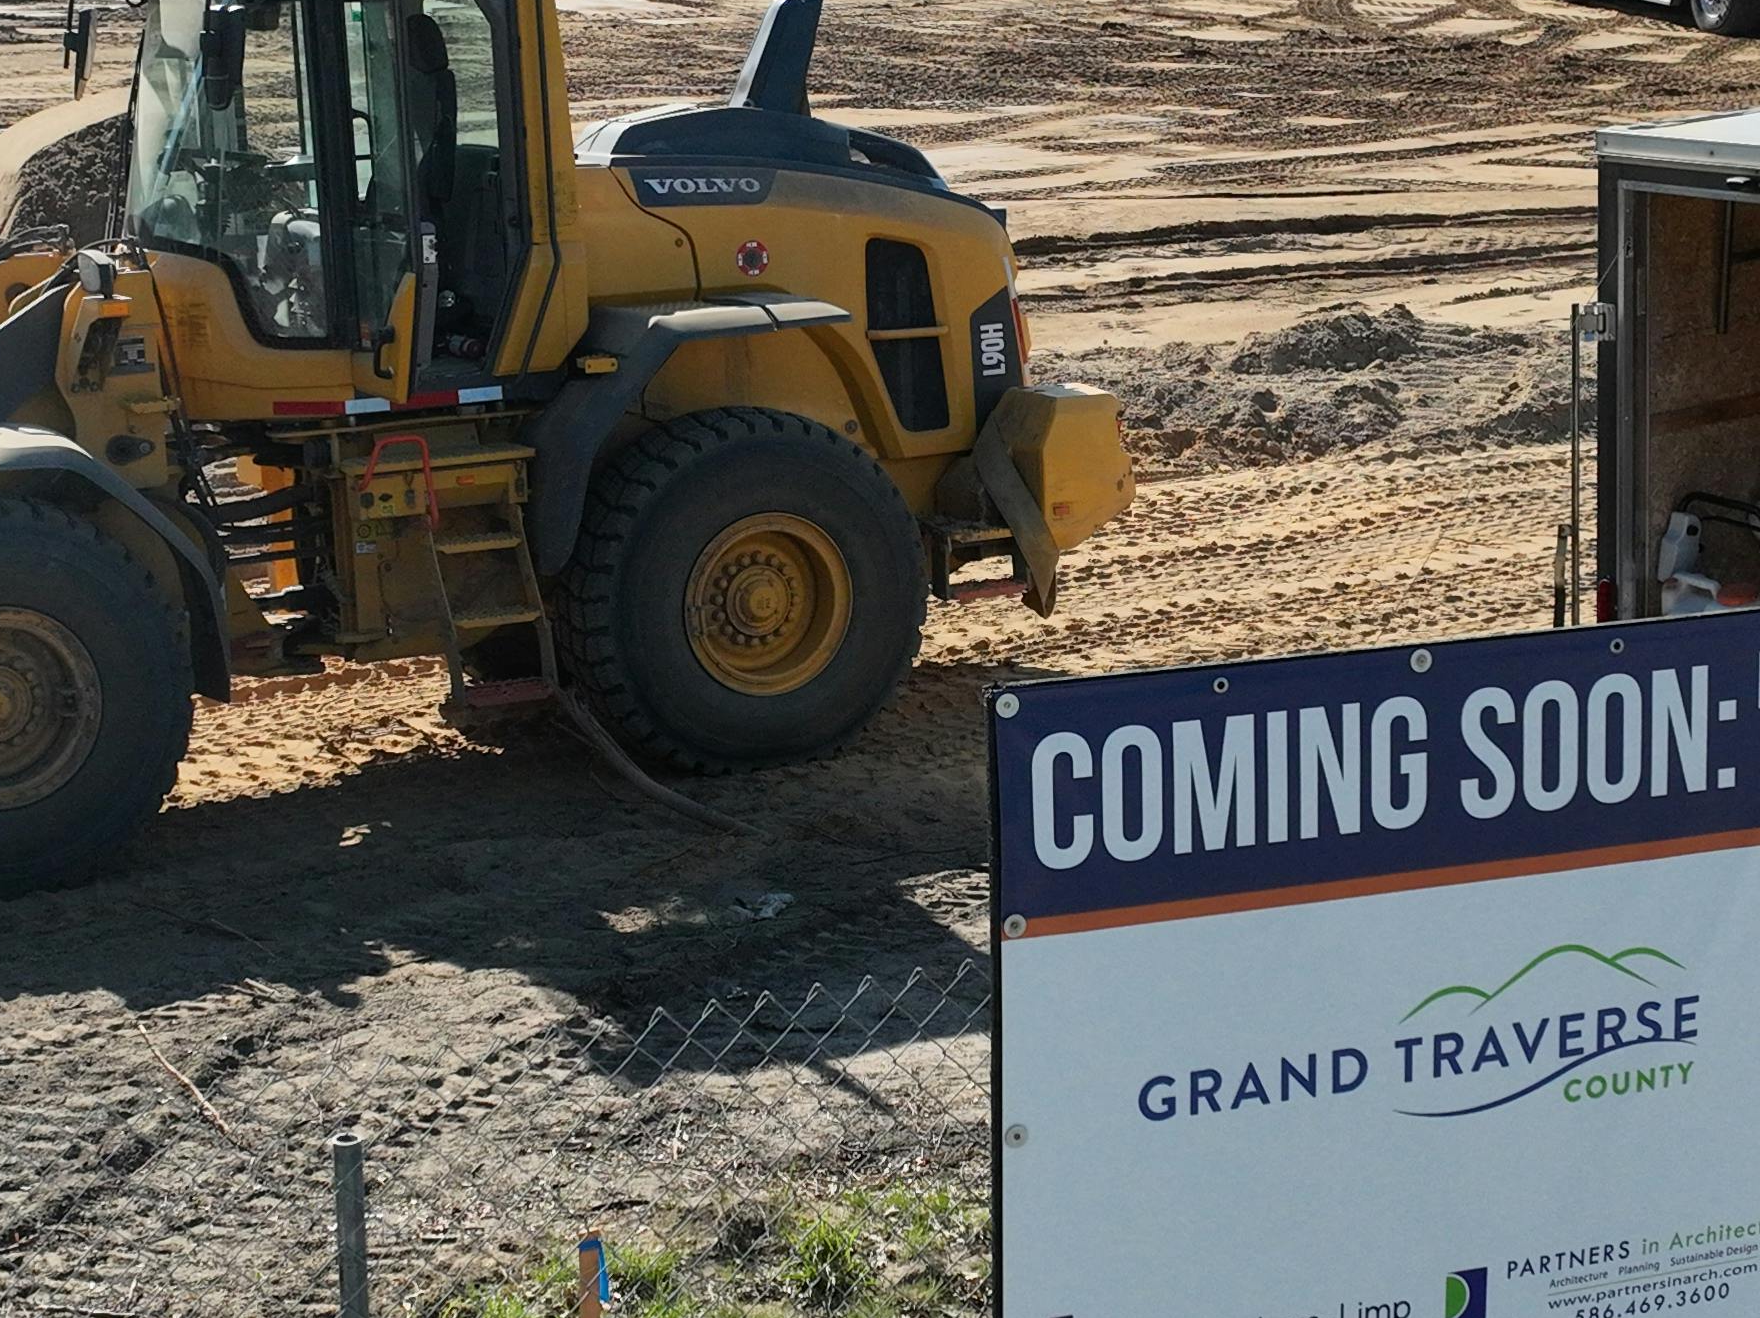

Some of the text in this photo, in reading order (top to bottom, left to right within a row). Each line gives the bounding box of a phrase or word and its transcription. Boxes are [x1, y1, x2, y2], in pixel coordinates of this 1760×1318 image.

[644, 177, 761, 194] VOLVO
[980, 323, 1006, 377] L90H
[1031, 665, 1737, 871] COMING SOON:
[1138, 995, 1700, 1121] GRAND TRAVERSE
[1563, 1061, 1694, 1103] COUNTY
[1507, 1241, 1631, 1280] PARTNERS
[1641, 1238, 1659, 1256] in
[1549, 1242, 1758, 1290] Architecture Planning Sustainable Design
[1547, 1261, 1758, 1311] www.partnersinarch.com
